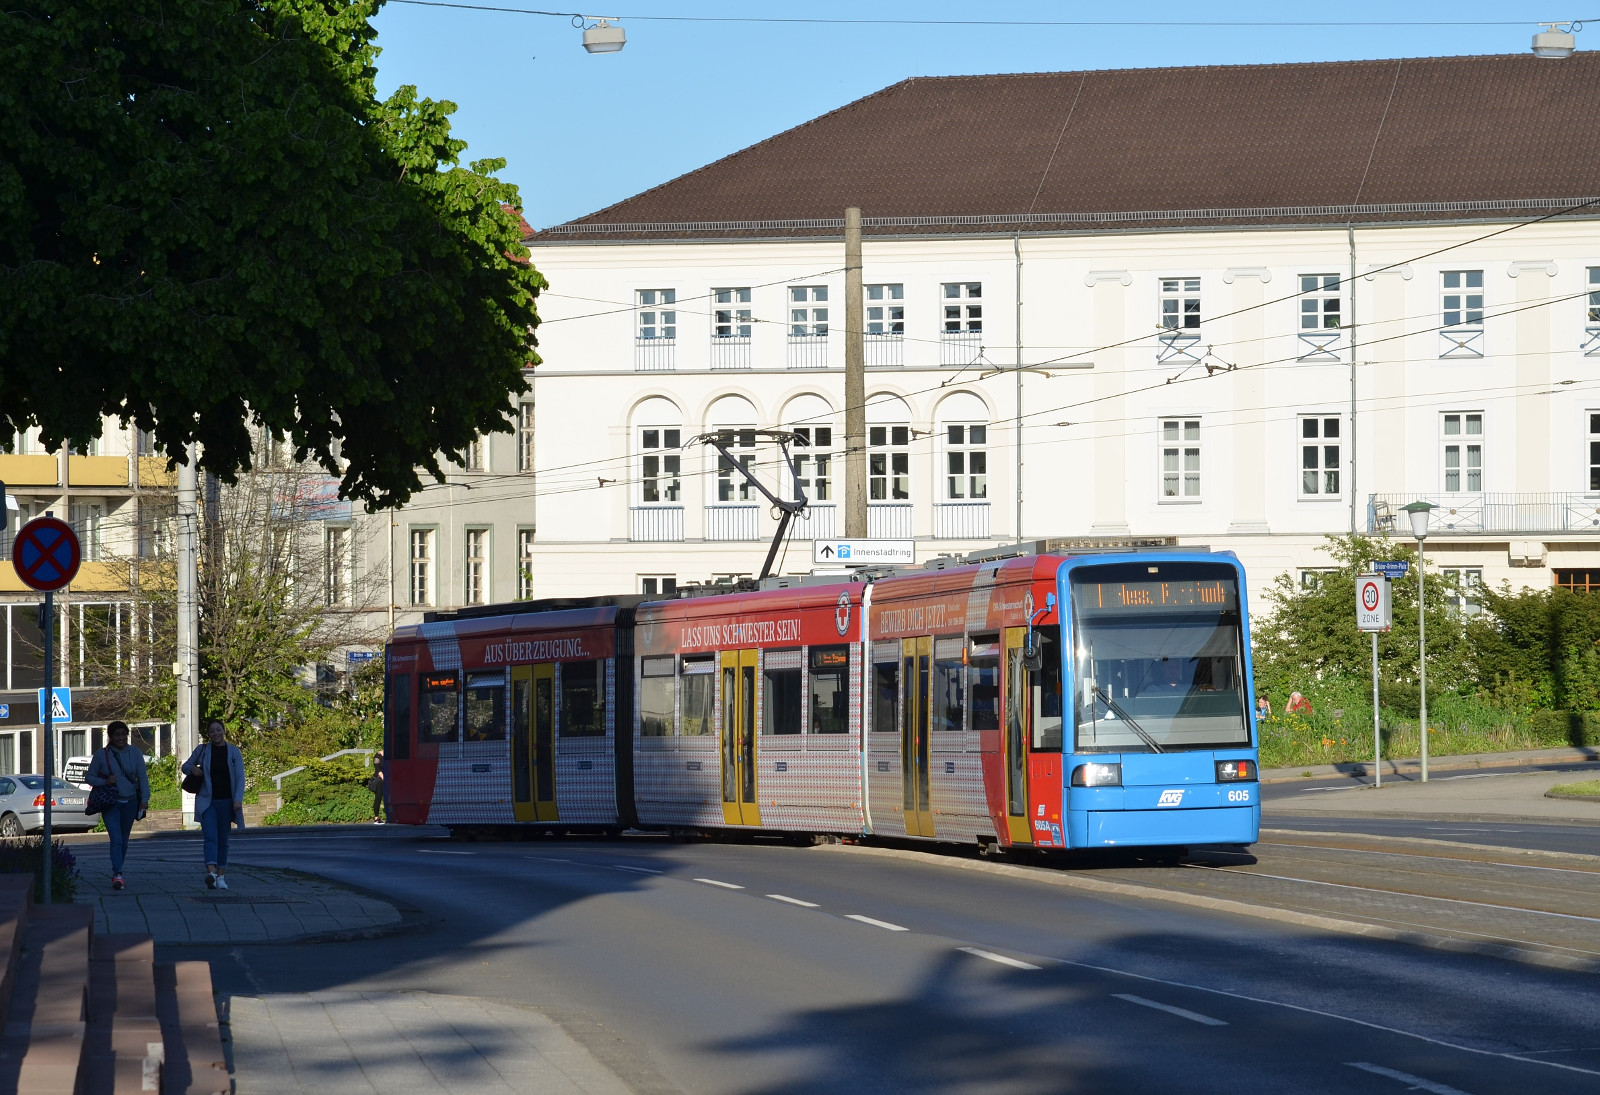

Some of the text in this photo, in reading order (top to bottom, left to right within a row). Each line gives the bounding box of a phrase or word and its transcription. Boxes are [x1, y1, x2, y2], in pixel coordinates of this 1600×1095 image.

[853, 548, 911, 557] Innenstadtring
[1366, 590, 1375, 604] 30
[880, 604, 947, 633] BEWIRB DICH JETZT.
[1363, 614, 1379, 623] ZONE
[681, 619, 801, 648] LASS UNS SCHWESTER SEIN!
[484, 638, 590, 663] AUS ÜBERZEUGUNG...
[1158, 790, 1184, 805] KVG
[1227, 790, 1250, 802] 605
